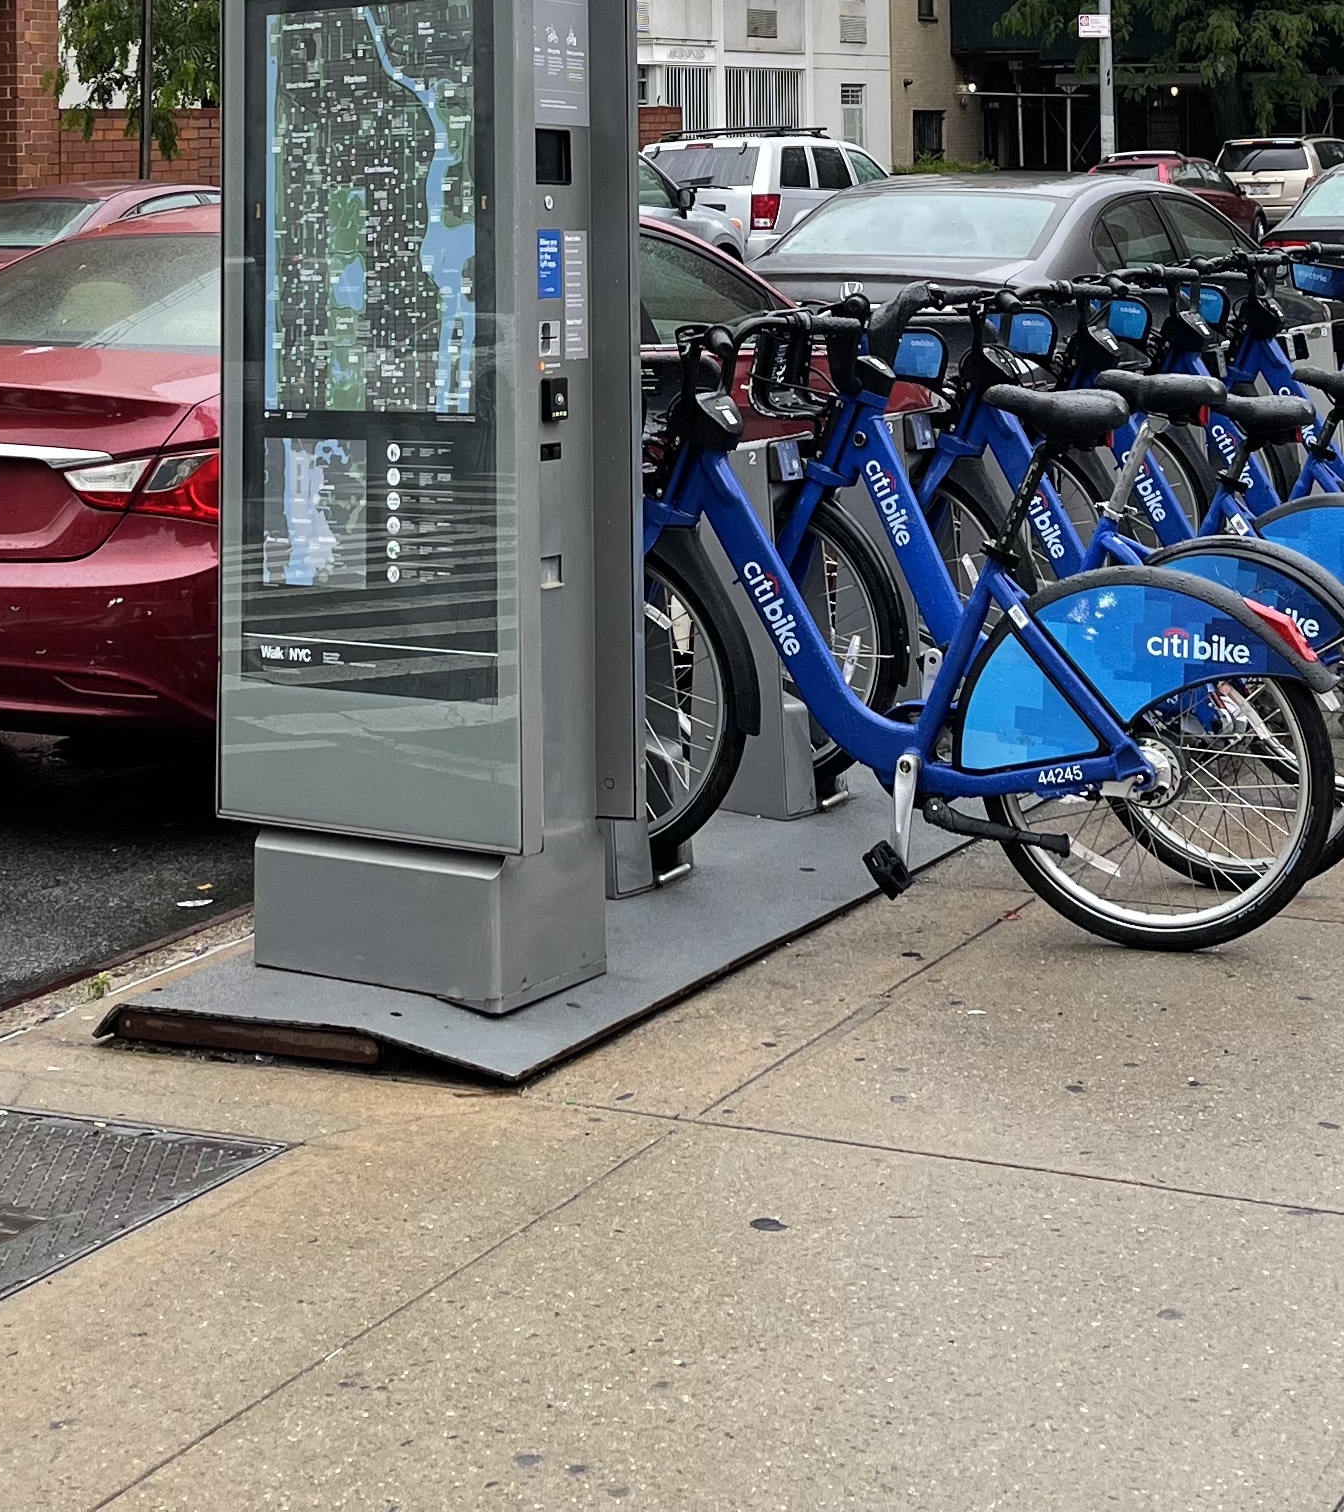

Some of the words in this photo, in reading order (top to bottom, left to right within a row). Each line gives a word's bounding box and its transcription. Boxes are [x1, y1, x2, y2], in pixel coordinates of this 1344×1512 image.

[748, 451, 758, 467] 2
[260, 644, 284, 660] Walk
[289, 647, 312, 662] NYC
[1038, 765, 1083, 785] 44245
